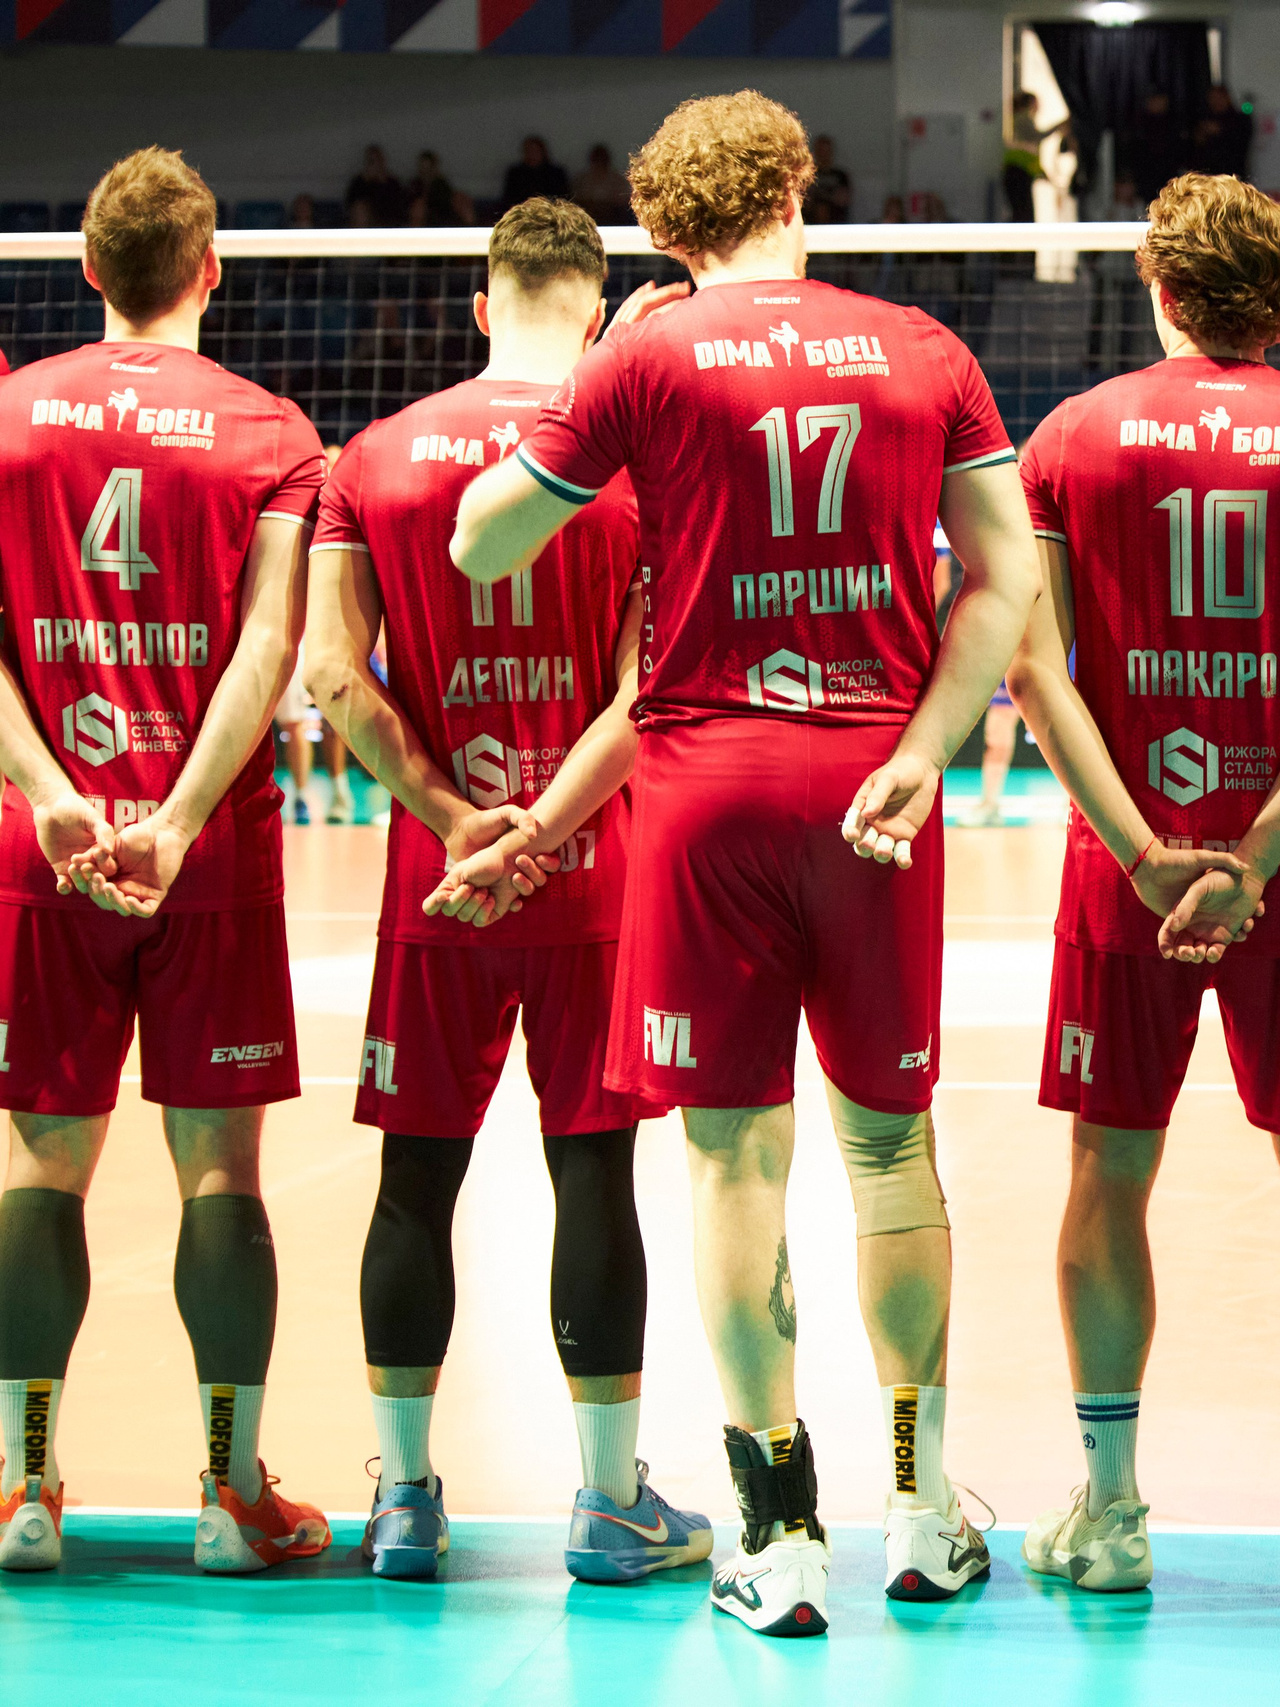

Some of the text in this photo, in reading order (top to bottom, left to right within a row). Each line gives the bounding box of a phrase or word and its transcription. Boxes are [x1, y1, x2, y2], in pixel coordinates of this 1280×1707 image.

[693, 336, 887, 371] DIMA БОЕЦ
[827, 363, 890, 378] company
[31, 399, 216, 437] DIMA БОЕЦ
[151, 434, 214, 451] company
[411, 435, 485, 467] DIMA
[1120, 419, 1197, 452] DIMA
[748, 403, 862, 537] 17
[80, 467, 160, 590] 4
[1153, 487, 1268, 619] 10
[732, 564, 892, 620] ПАРШИН
[33, 618, 208, 667] ПРИВАЛОВ
[442, 656, 575, 708] ДЕМИН
[826, 658, 884, 674] ИЖОРА
[827, 674, 878, 690] СТАЛЬ
[829, 688, 889, 704] ИНВЕСТ
[130, 710, 184, 723] ИЖОРА
[131, 725, 180, 738] СТАЛЬ
[132, 740, 190, 753] ИНВЕСТ
[1224, 746, 1277, 758] ИЖОРА
[1224, 761, 1273, 775] СТАЛЬ
[1224, 777, 1275, 790] ИНВЕС
[210, 1041, 284, 1063] ENSEN
[644, 1010, 697, 1068] FVL
[359, 1039, 398, 1095] FVL
[25, 1391, 50, 1479] MIOFORM
[894, 1400, 917, 1493] MIOFORM
